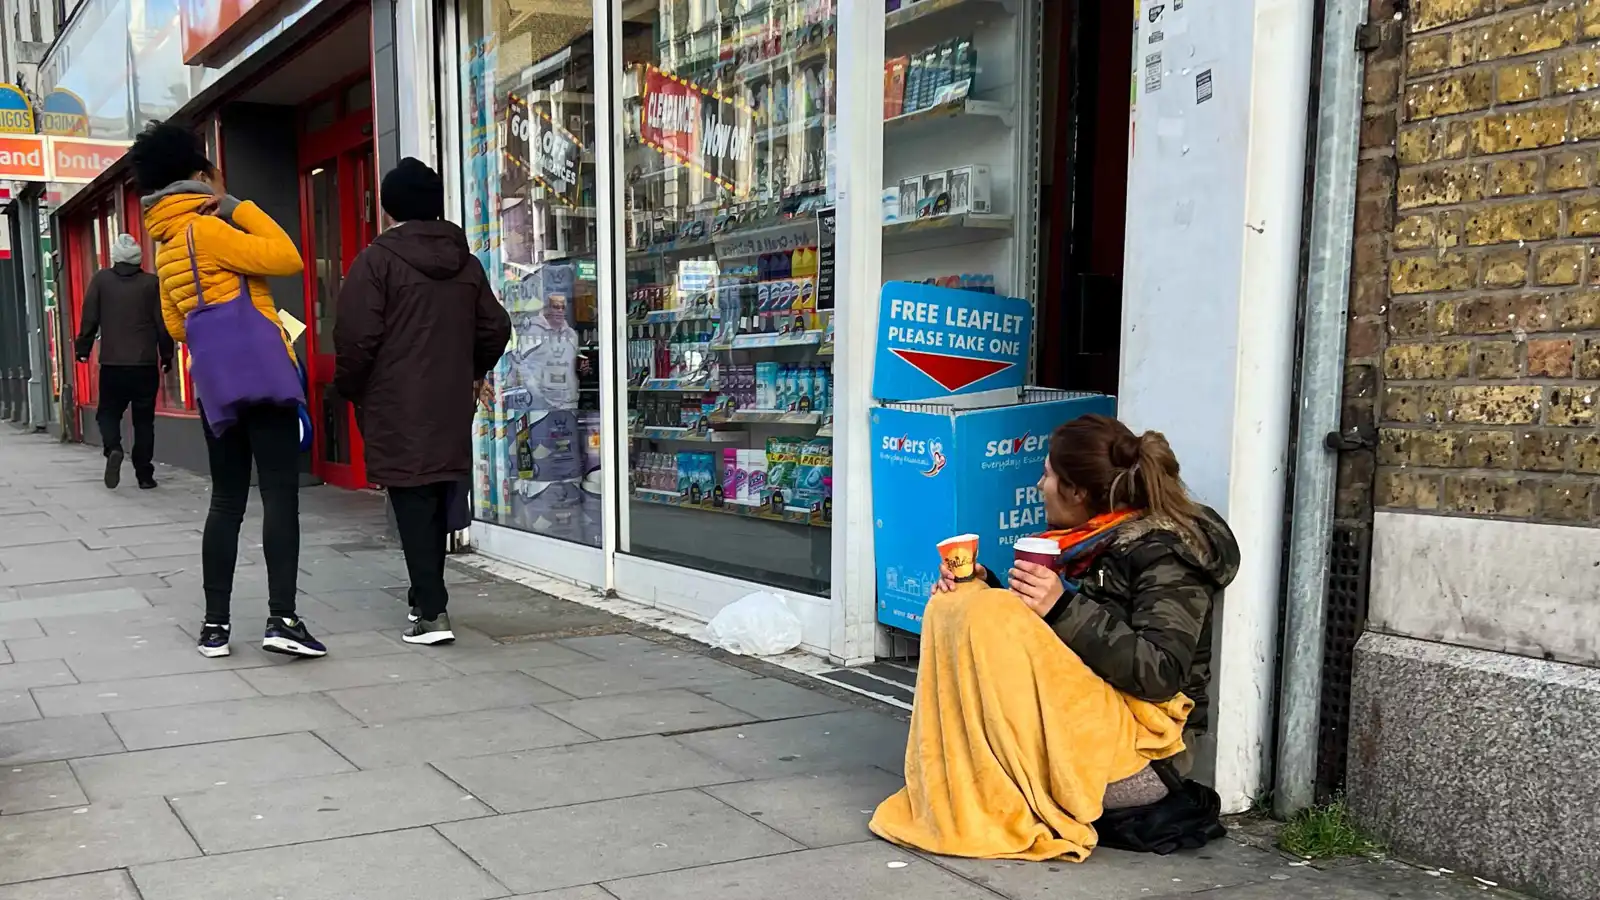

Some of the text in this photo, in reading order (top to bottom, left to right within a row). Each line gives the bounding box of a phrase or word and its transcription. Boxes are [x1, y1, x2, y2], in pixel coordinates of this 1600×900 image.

[0, 111, 31, 128] IGOS
[890, 299, 1023, 335] FREE LEAFLET
[888, 326, 1020, 356] PLEASE TAKE ONE
[882, 433, 925, 455] savers
[985, 429, 1052, 457] saver
[981, 457, 1020, 472] Everyday
[1015, 486, 1045, 506] FR
[999, 506, 1048, 530] LEAF
[998, 533, 1029, 546] PLEA
